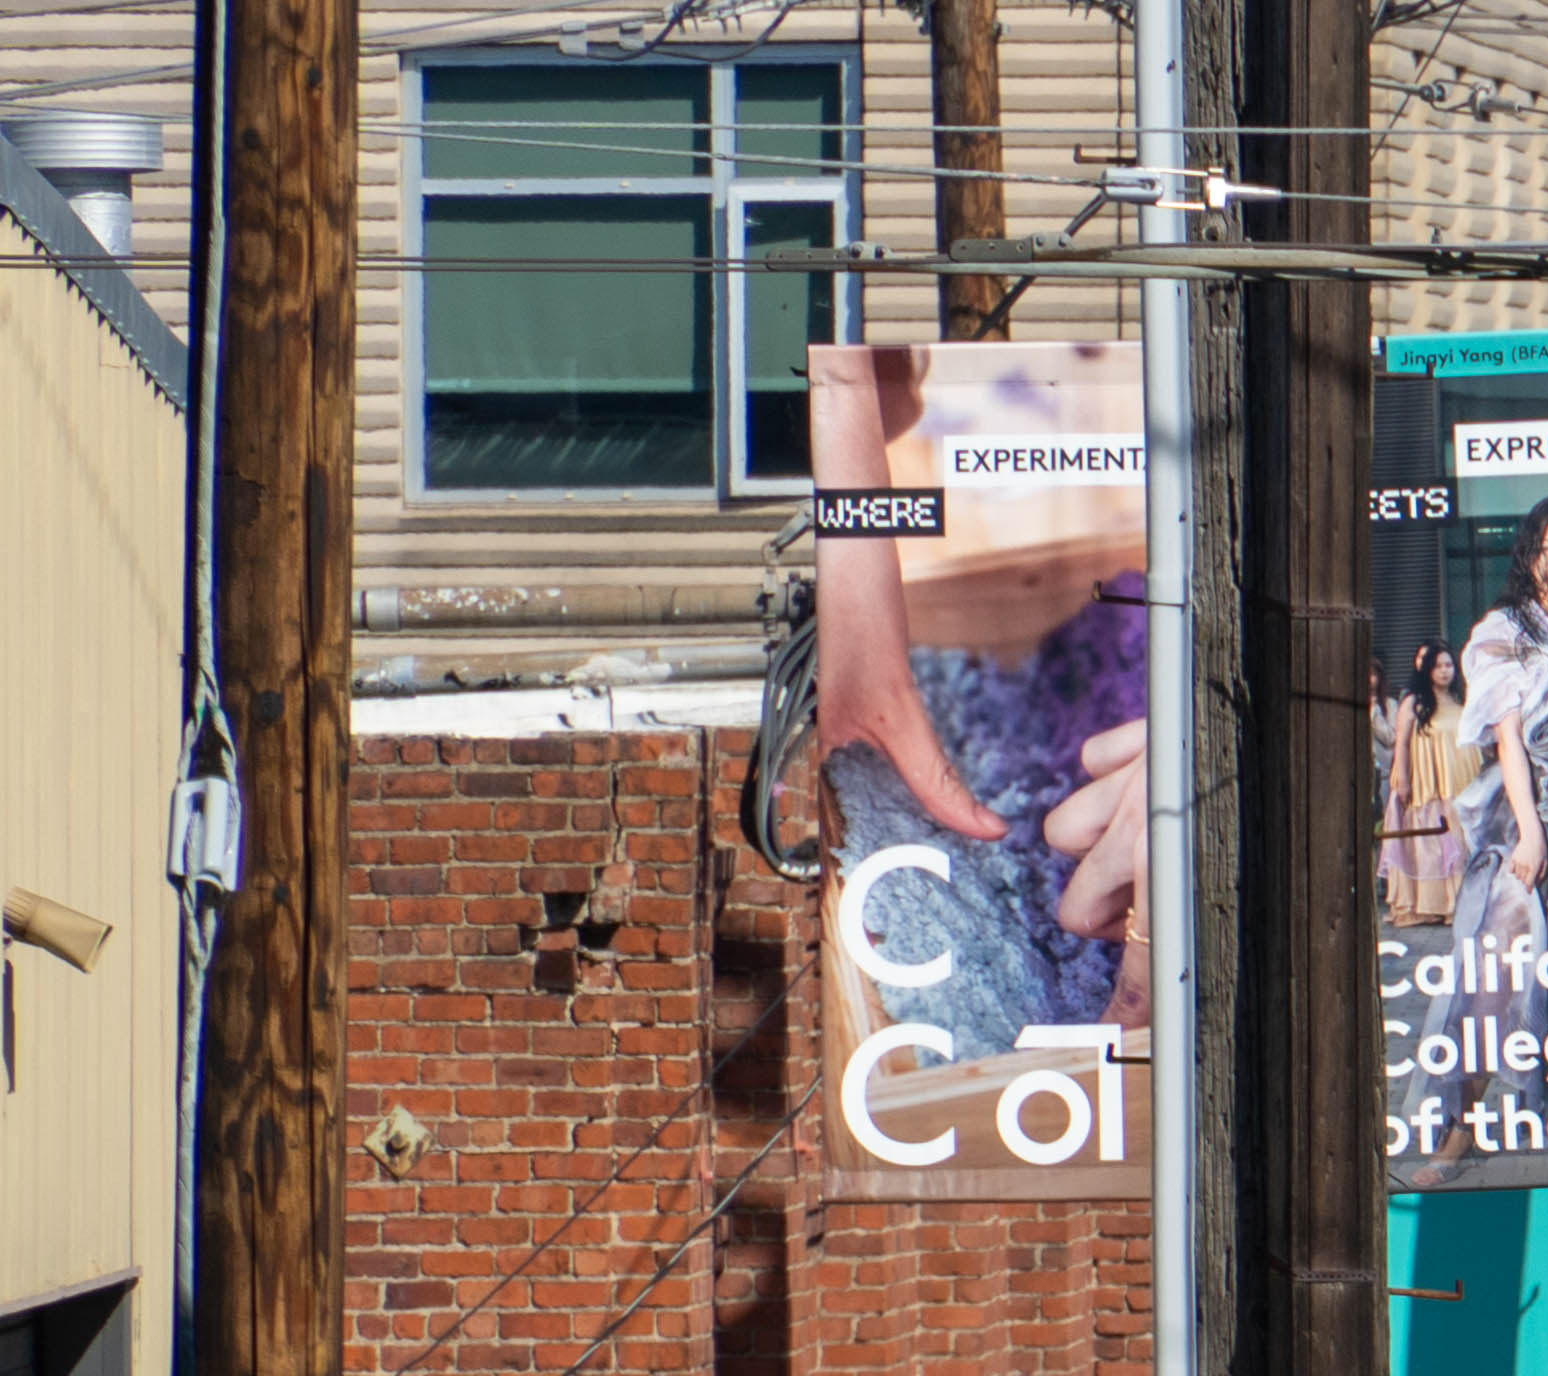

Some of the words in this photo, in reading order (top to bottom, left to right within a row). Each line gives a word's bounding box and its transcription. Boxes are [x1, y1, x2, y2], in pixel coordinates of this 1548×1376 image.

[1400, 347, 1455, 367] Jingyi
[1460, 348, 1504, 366] Yang
[955, 446, 1146, 474] EXPERIMENT
[818, 496, 937, 530] WHERE
[1370, 486, 1449, 520] ETS
